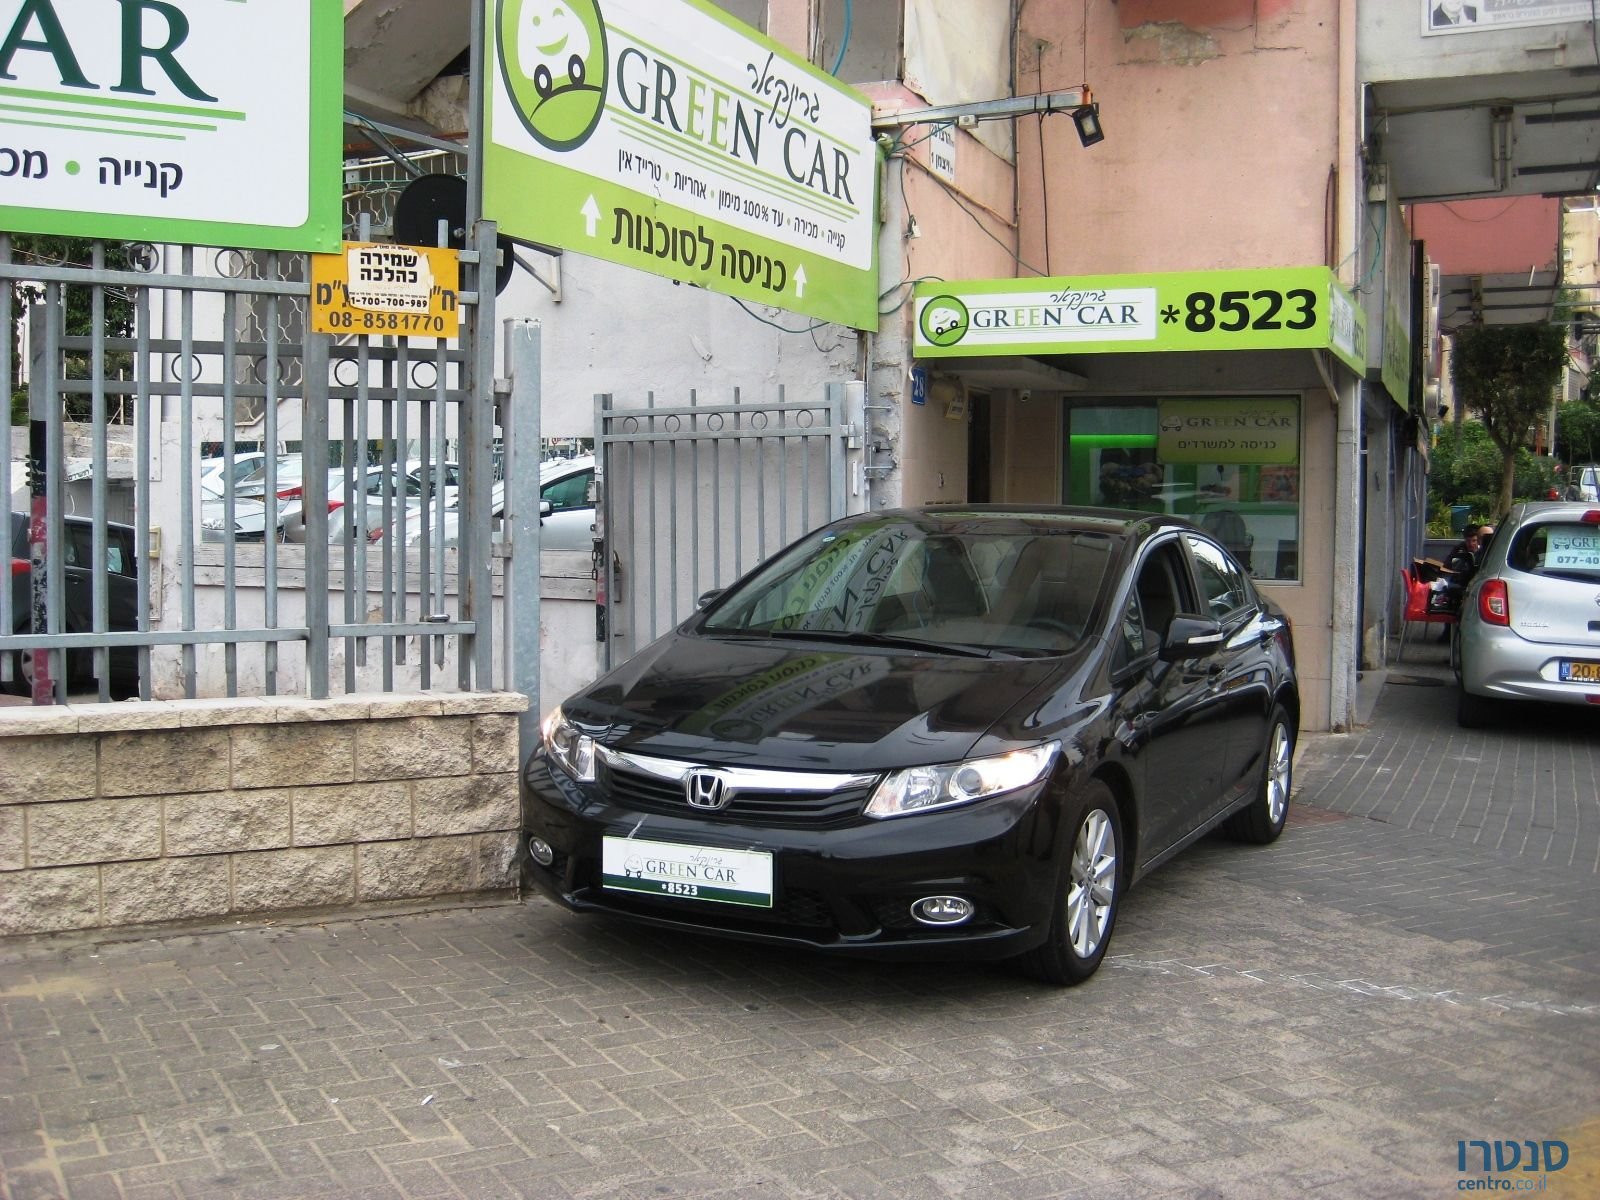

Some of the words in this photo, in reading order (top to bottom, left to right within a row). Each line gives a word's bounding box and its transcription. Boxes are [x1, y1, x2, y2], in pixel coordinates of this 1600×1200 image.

[617, 47, 764, 165] GREEN
[783, 127, 854, 205] CAR
[618, 148, 632, 172] אין
[635, 155, 662, 181] טרייד
[100, 156, 184, 197] קנייה
[674, 171, 707, 200] אחריות
[718, 189, 741, 211] מימון
[743, 199, 769, 222] 100%
[771, 208, 784, 227] עד
[794, 216, 818, 239] מכירה
[611, 207, 714, 271] לסוכנות
[827, 229, 846, 252] קנייה
[360, 252, 418, 267] שמירה
[721, 243, 787, 292] כניסה
[360, 267, 418, 283] כהלכה
[351, 297, 428, 308] 1-700-700-989
[329, 311, 444, 332] 08-8581770
[973, 307, 1063, 327] GREEN
[1077, 305, 1139, 325] CAR
[1186, 417, 1247, 427] GREEN
[1255, 417, 1291, 427] CAR
[1178, 438, 1236, 449] למשרדים
[1240, 440, 1277, 449] כניסה
[646, 860, 698, 878] GREEN
[704, 866, 737, 883] CAR
